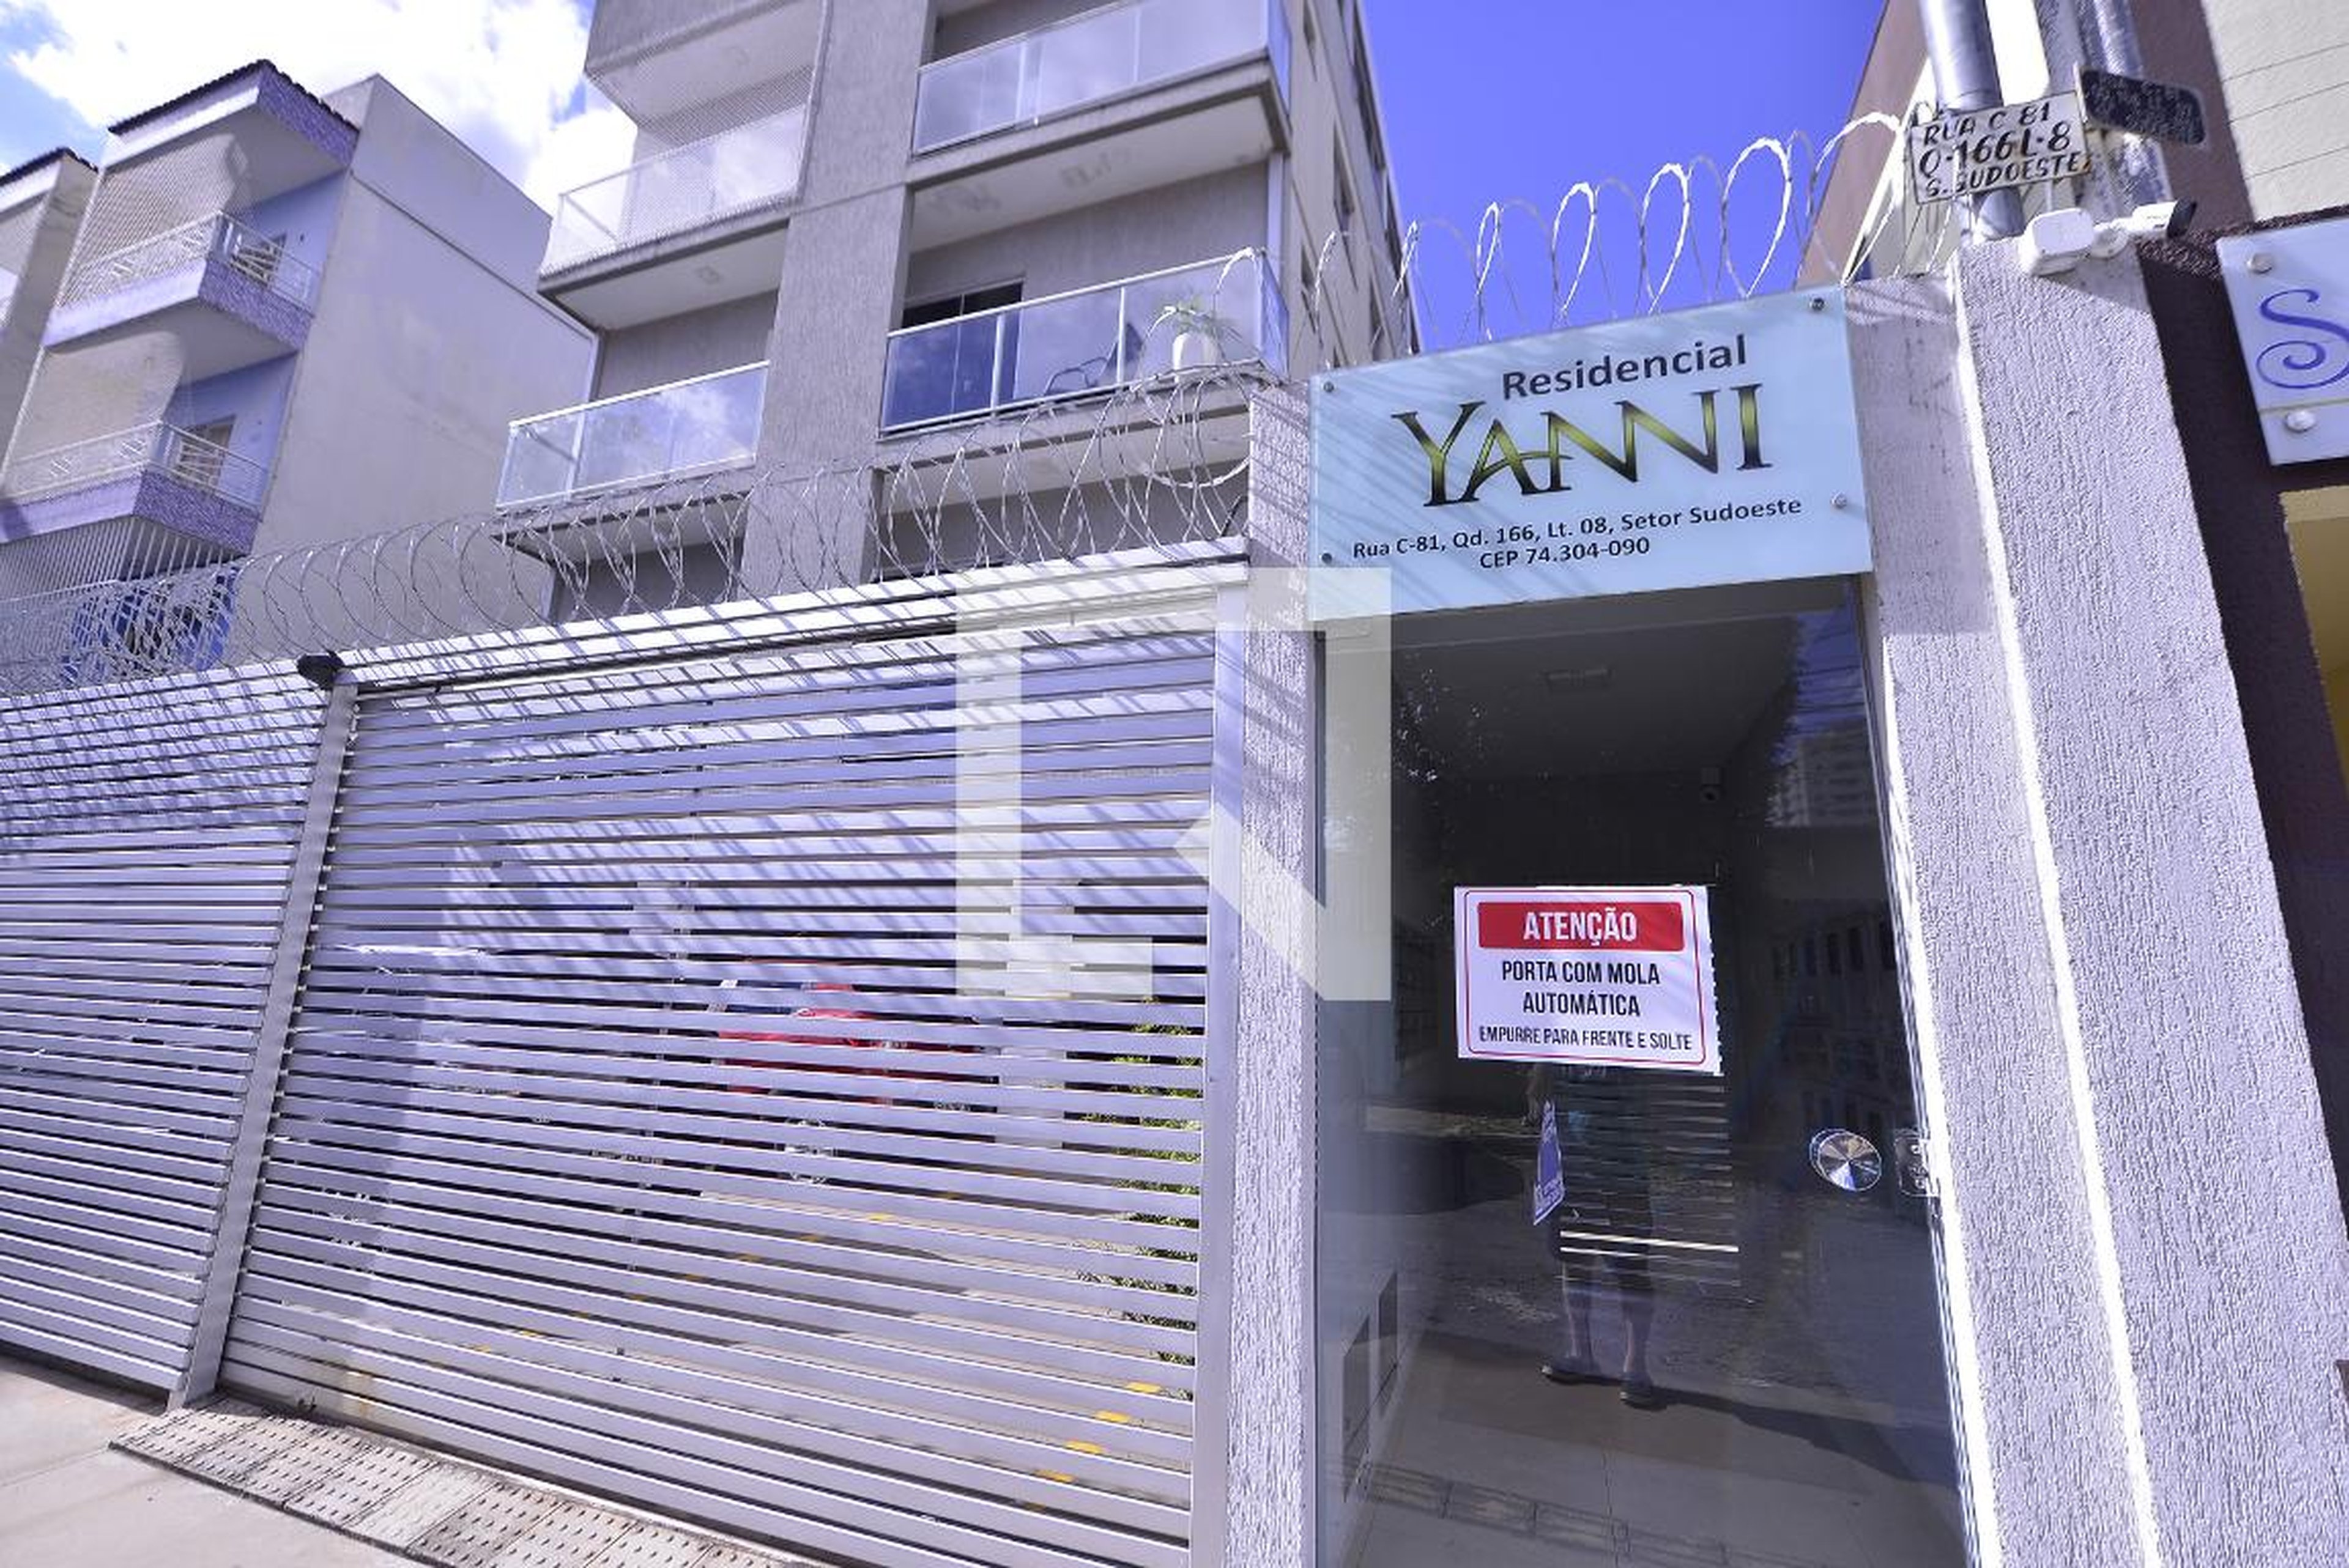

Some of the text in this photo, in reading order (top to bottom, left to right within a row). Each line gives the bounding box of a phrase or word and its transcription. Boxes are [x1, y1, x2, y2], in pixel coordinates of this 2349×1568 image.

[1990, 111, 2007, 129] C
[1502, 333, 1748, 400] Residencial
[1390, 383, 1772, 507] YANNI
[1353, 498, 1803, 559] Rua C-81, Qd. 166, Lt. 08, Setor Sudoeste
[1480, 536, 1651, 569] CEP 74.304-090
[1523, 907, 1638, 947] ATENÇÃO
[1502, 960, 1660, 985] PORTA COM MOLA
[1523, 989, 1641, 1017] AUTOMÁTICA
[1479, 1026, 1692, 1051] EMPURRE PARA FRENTE E SOLTE
